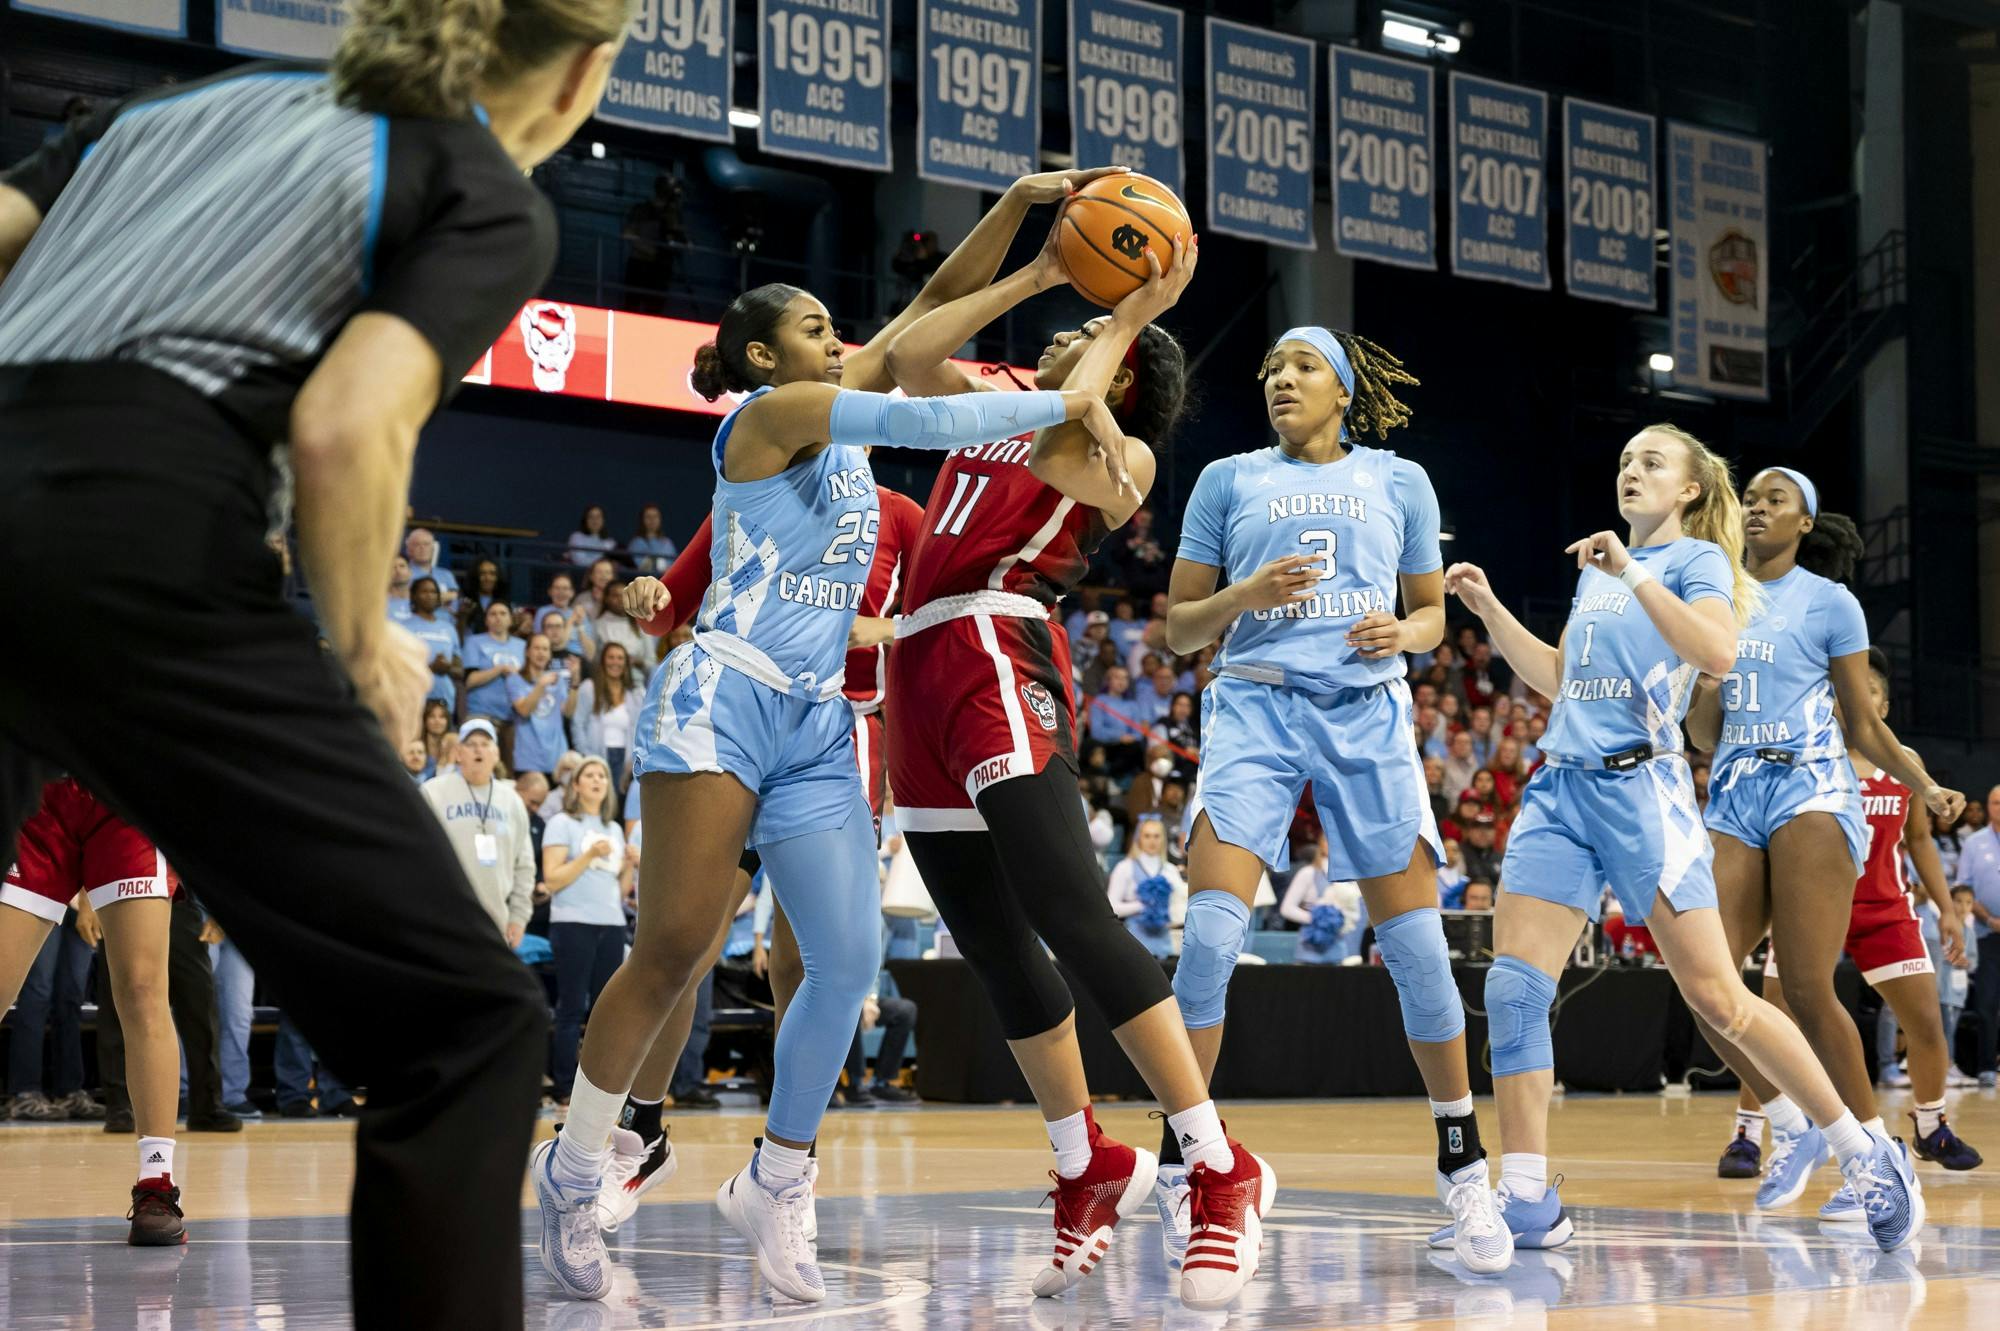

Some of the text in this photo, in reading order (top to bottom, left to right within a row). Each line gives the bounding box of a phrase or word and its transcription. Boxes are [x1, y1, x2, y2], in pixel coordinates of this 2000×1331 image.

[630, 0, 726, 57] 994
[930, 8, 1032, 52] BASKETBALL
[644, 51, 685, 80] ACC
[768, 10, 884, 88] 1995
[1079, 39, 1175, 83] BASKETBALL
[607, 77, 722, 122] CHAMPIONS
[805, 82, 845, 113] ACC
[931, 43, 1031, 118] 1997
[1215, 71, 1307, 113] BASKETBALL
[770, 108, 880, 151] CHAMPIONS
[961, 111, 998, 142] ACC
[1078, 73, 1179, 148] 1998
[1341, 96, 1426, 137] BASKETBALL
[929, 136, 1032, 176] CHAMPIONS
[1110, 143, 1146, 171] ACC
[1214, 103, 1311, 174] 2005
[1459, 121, 1541, 161] BASKETBALL
[1245, 168, 1279, 198] ACC
[1338, 128, 1429, 198] 2006
[1572, 145, 1649, 183] BASKETBALL
[1369, 191, 1400, 219] ACC
[1460, 153, 1542, 218] 2007
[1217, 191, 1306, 232] CHAMPIONS
[1487, 213, 1516, 240] ACC
[1571, 175, 1650, 242] 2008
[1341, 215, 1427, 254] CHAMPIONS
[1599, 236, 1627, 262] ACC
[1461, 237, 1541, 275] CHAMPIONS
[1573, 258, 1650, 295] CHAMPIONS
[933, 470, 992, 537] 11
[1267, 493, 1368, 524] NORTH
[820, 508, 880, 566] 25
[1298, 528, 1338, 581] 3
[1580, 622, 1595, 667] 1
[1736, 639, 1777, 665] RTH
[1722, 671, 1762, 712] 31
[974, 757, 1011, 789] PACK
[1861, 795, 1902, 816] TATE
[117, 879, 154, 897] PACK
[1902, 961, 1928, 974] PACK
